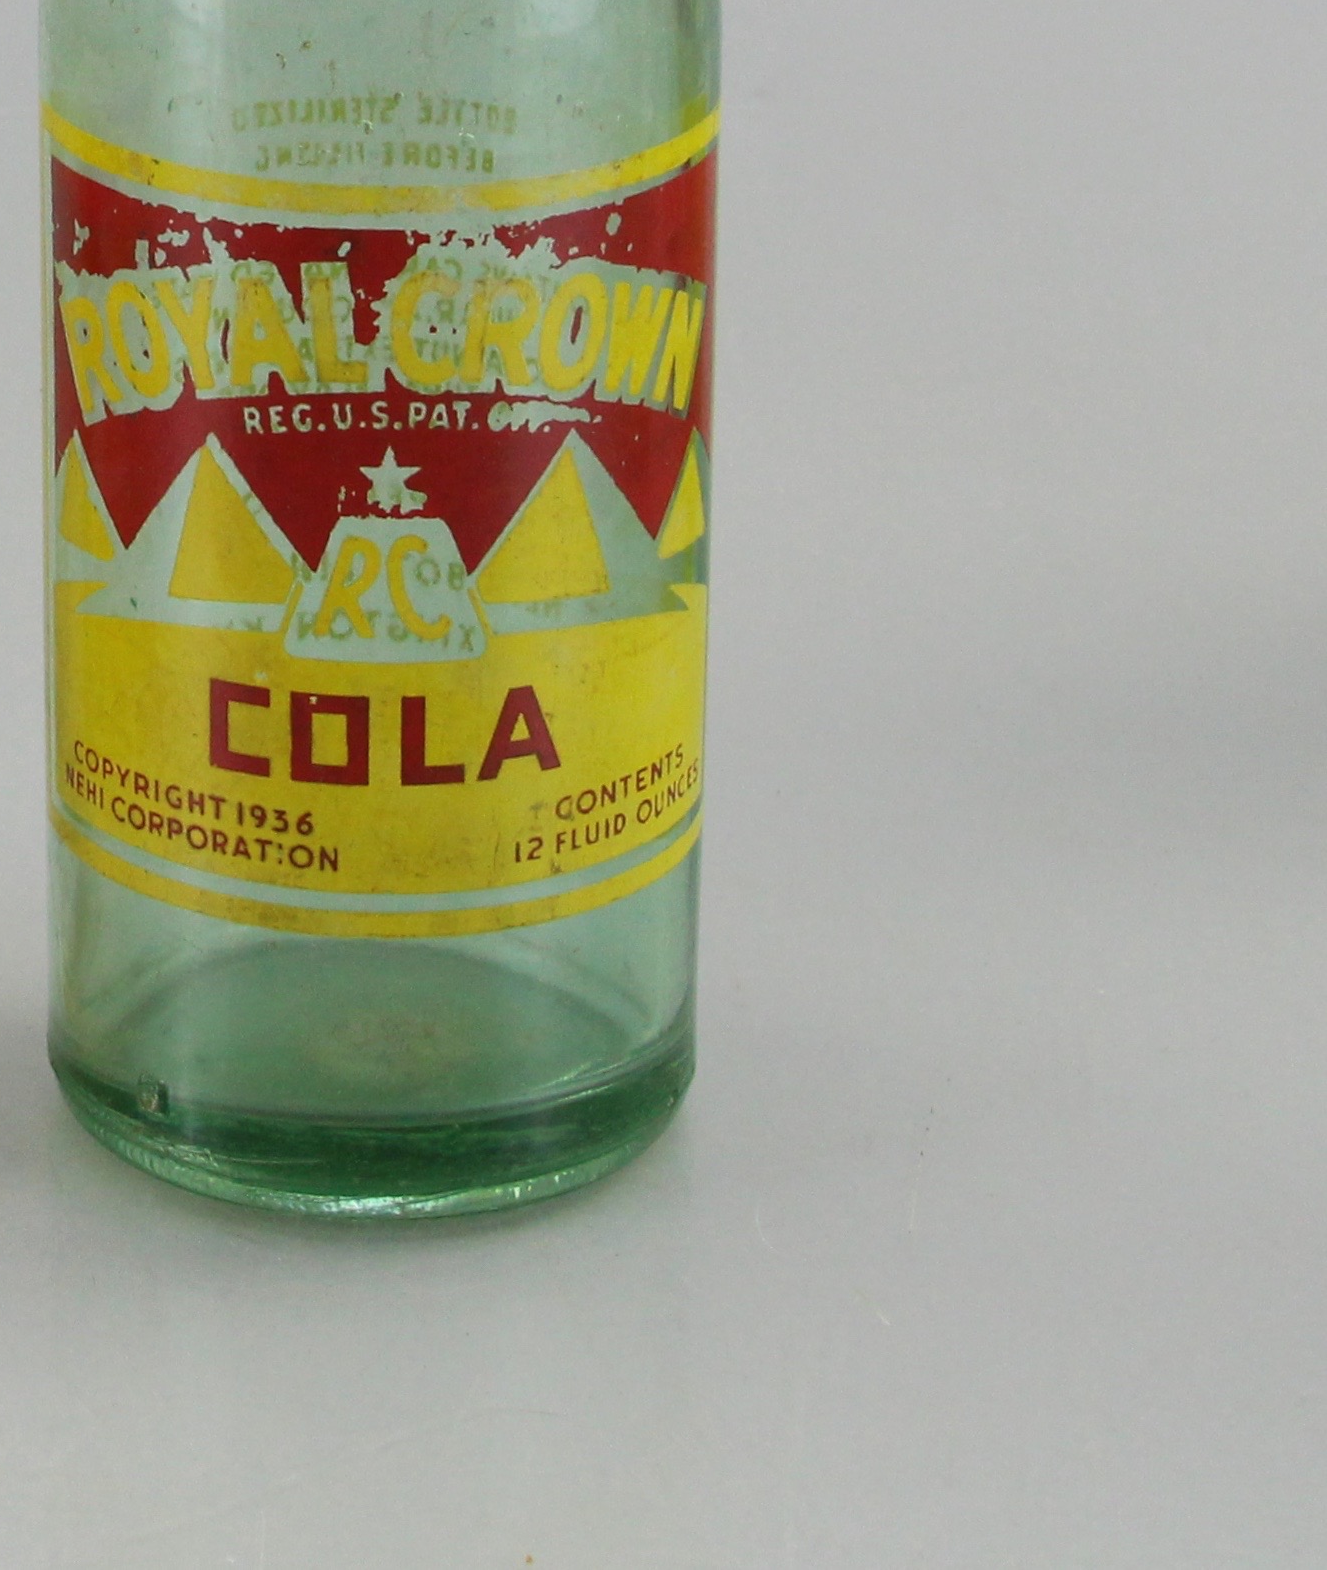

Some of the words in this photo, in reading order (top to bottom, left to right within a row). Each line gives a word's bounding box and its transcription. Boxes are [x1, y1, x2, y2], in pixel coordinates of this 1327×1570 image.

[59, 272, 369, 404] ROYAL
[388, 271, 704, 411] CROWN
[319, 534, 452, 641] RC
[208, 677, 562, 787] COLA
[555, 742, 684, 820] CONTENTS
[65, 762, 105, 810] NEHI
[73, 739, 227, 820] COPYRIGHT
[236, 801, 315, 836] 1936
[515, 836, 544, 863] 12
[556, 812, 626, 854] FLUID
[635, 757, 699, 824] OUNCES
